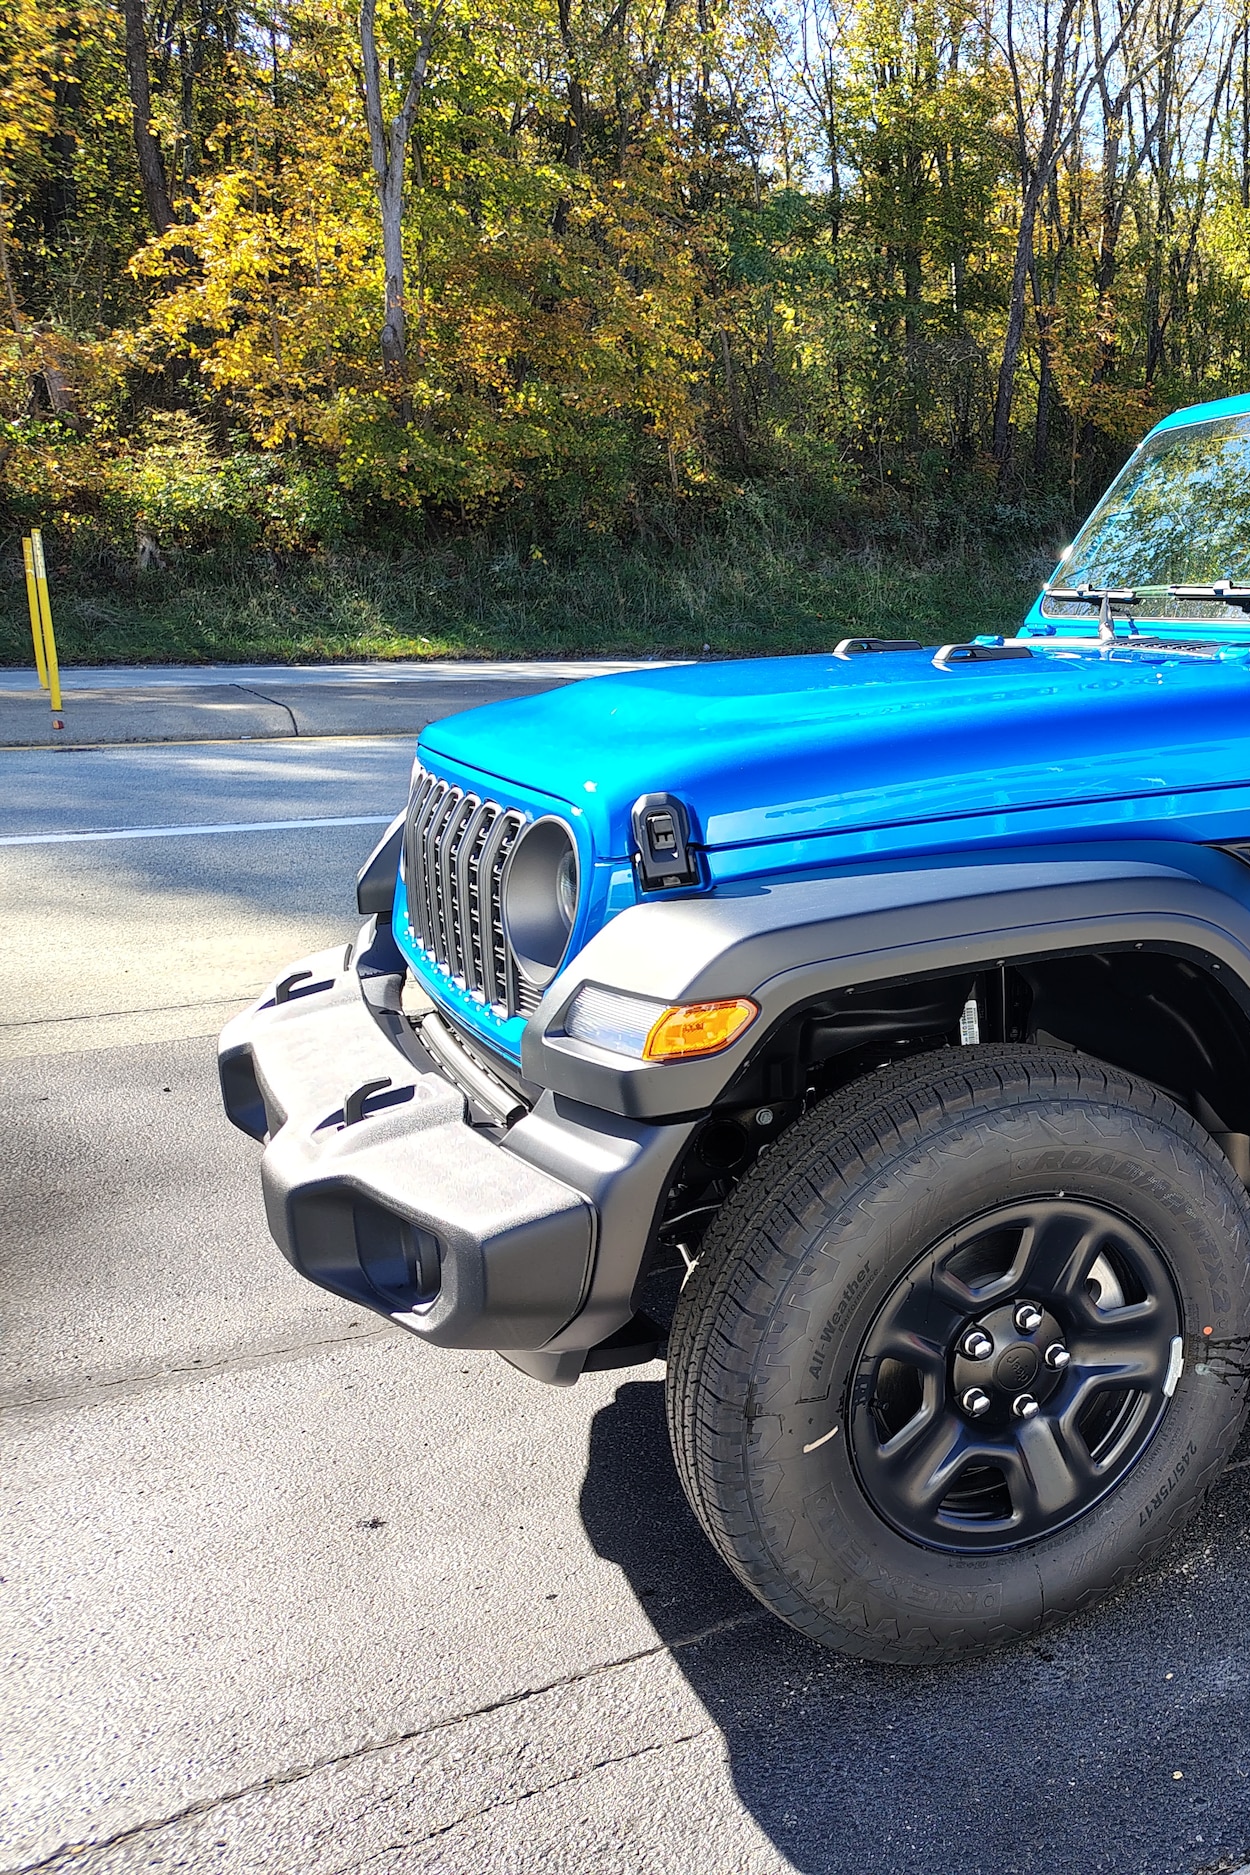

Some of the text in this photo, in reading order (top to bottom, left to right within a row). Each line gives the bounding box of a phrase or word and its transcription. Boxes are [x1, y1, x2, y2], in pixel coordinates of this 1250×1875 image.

[808, 1260, 870, 1381] All-Weather
[1006, 1355, 1030, 1382] Jeep
[1138, 1439, 1198, 1528] 245/75R17
[817, 1509, 980, 1614] NEXEN
